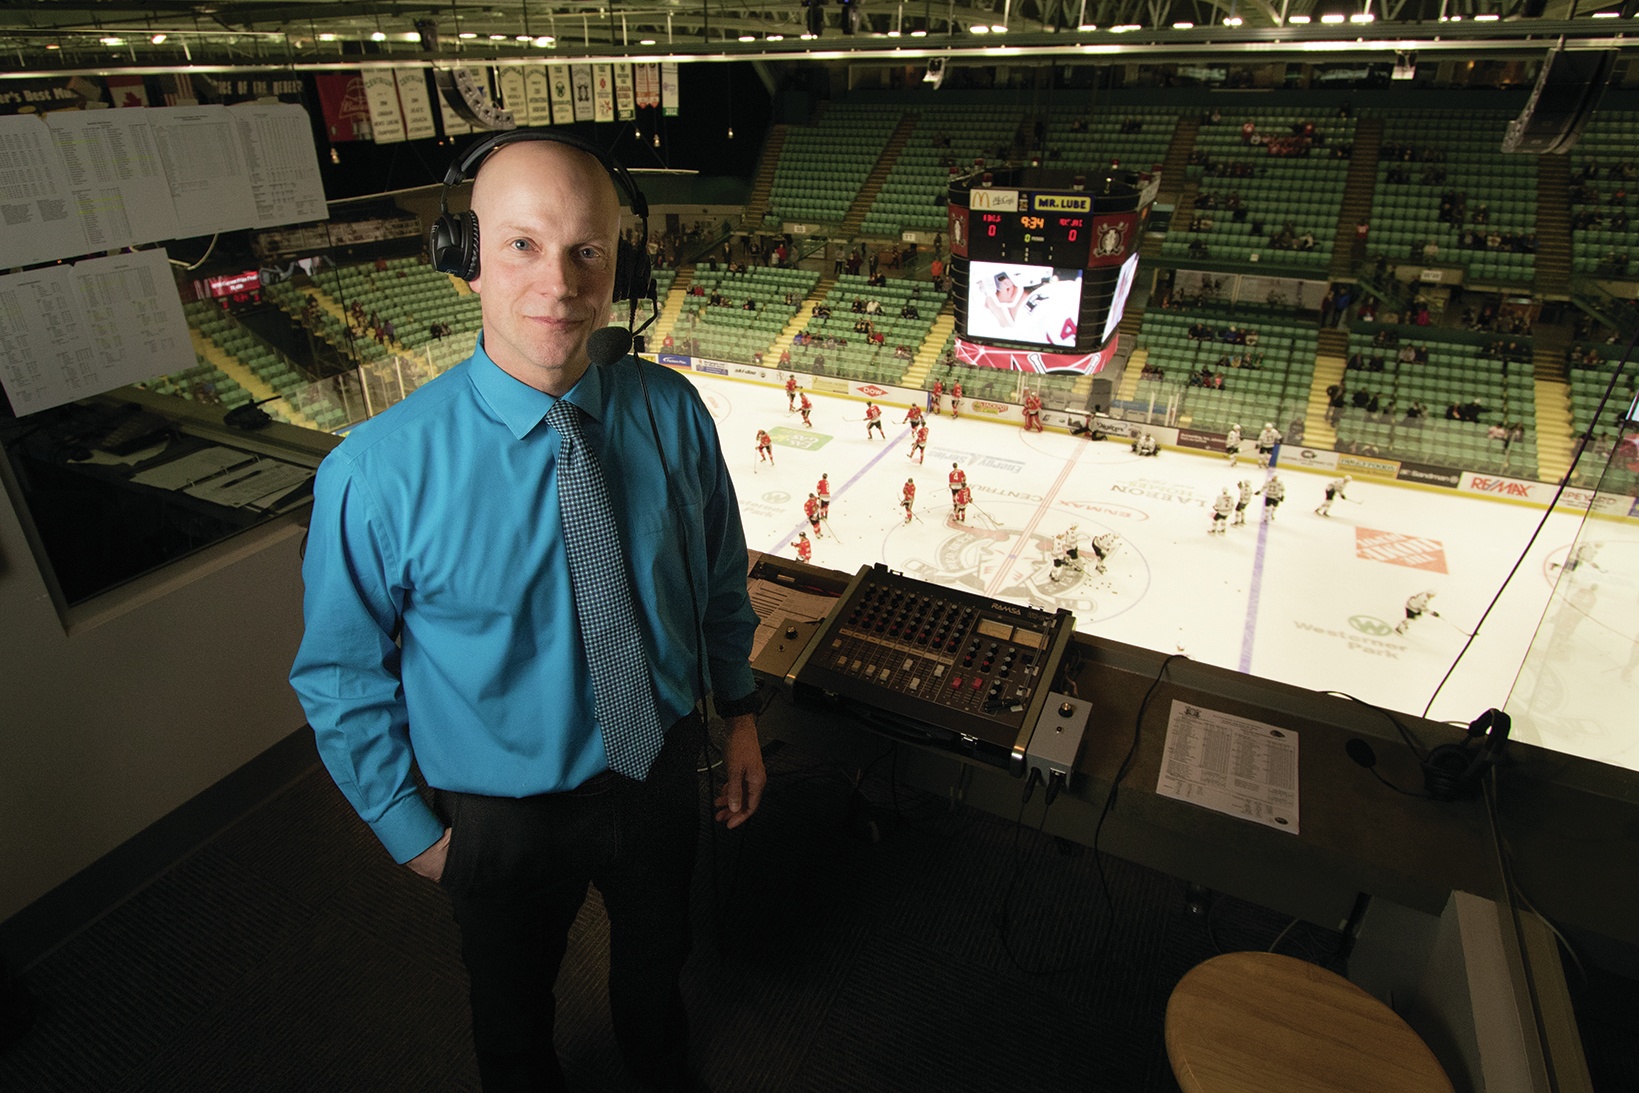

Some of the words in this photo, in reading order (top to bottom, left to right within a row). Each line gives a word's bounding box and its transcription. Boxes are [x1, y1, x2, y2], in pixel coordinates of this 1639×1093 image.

[1038, 198, 1060, 208] MR.
[1061, 199, 1087, 209] LUBE
[987, 224, 997, 237] 0
[1020, 216, 1045, 229] 9:34
[1067, 229, 1078, 242] 0
[863, 386, 883, 396] DOW
[978, 457, 1022, 475] Energy
[966, 482, 1044, 503] CENTRIU
[1471, 476, 1531, 498] RE/MAX
[1060, 499, 1133, 519] ENMAX
[990, 602, 1022, 616] RAMSA
[1293, 619, 1408, 652] Westerner
[1347, 640, 1400, 660] Park
